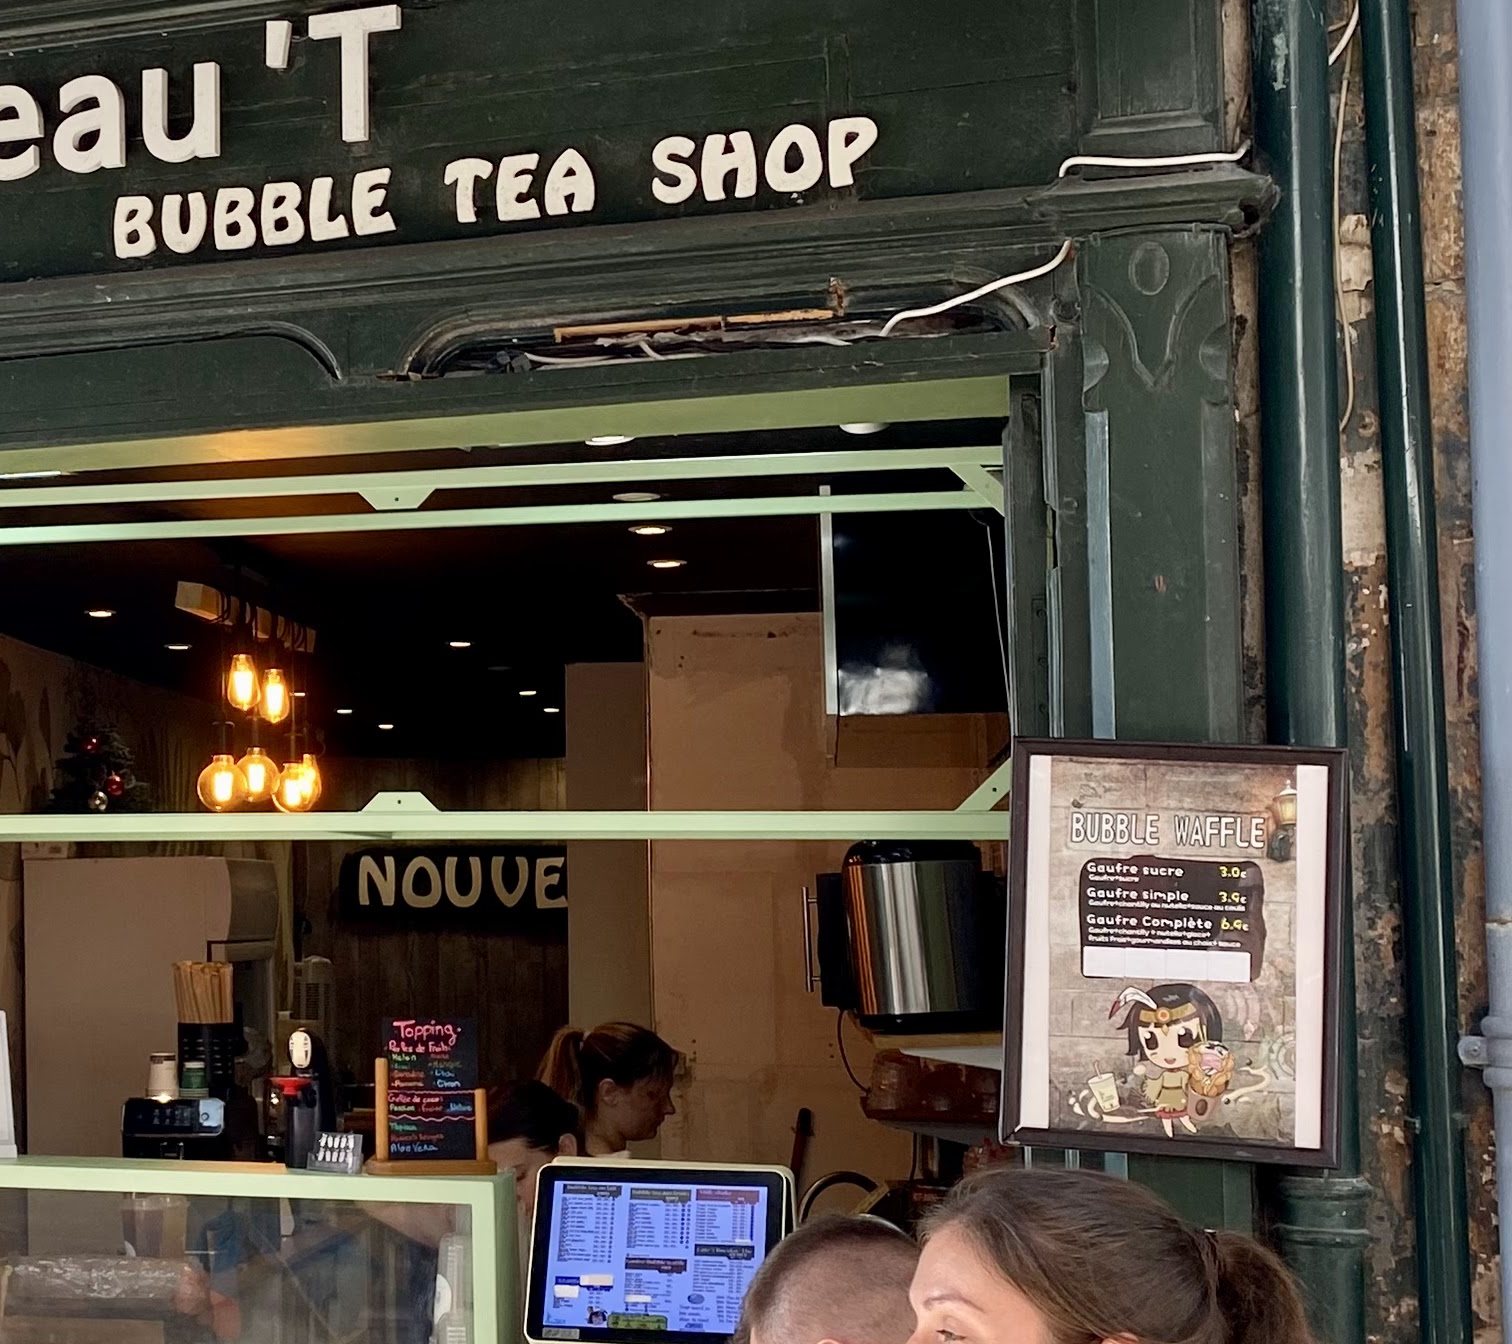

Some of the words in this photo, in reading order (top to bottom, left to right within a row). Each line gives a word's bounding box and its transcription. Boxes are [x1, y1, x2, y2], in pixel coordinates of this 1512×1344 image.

[265, 4, 402, 143] 'T
[113, 167, 397, 259] BUBBLE
[443, 147, 596, 224] TEA
[651, 115, 879, 204] SHOP
[1071, 812, 1160, 845] BUBBLE
[1174, 815, 1265, 848] WAFFLE
[1087, 862, 1138, 874] Gaufre
[1143, 866, 1184, 877] sucre
[1087, 887, 1138, 900] Gaufre
[1142, 889, 1189, 903] simple
[1087, 913, 1138, 926] Gaufre
[1142, 916, 1213, 930] Complète
[392, 1019, 458, 1046] Topping
